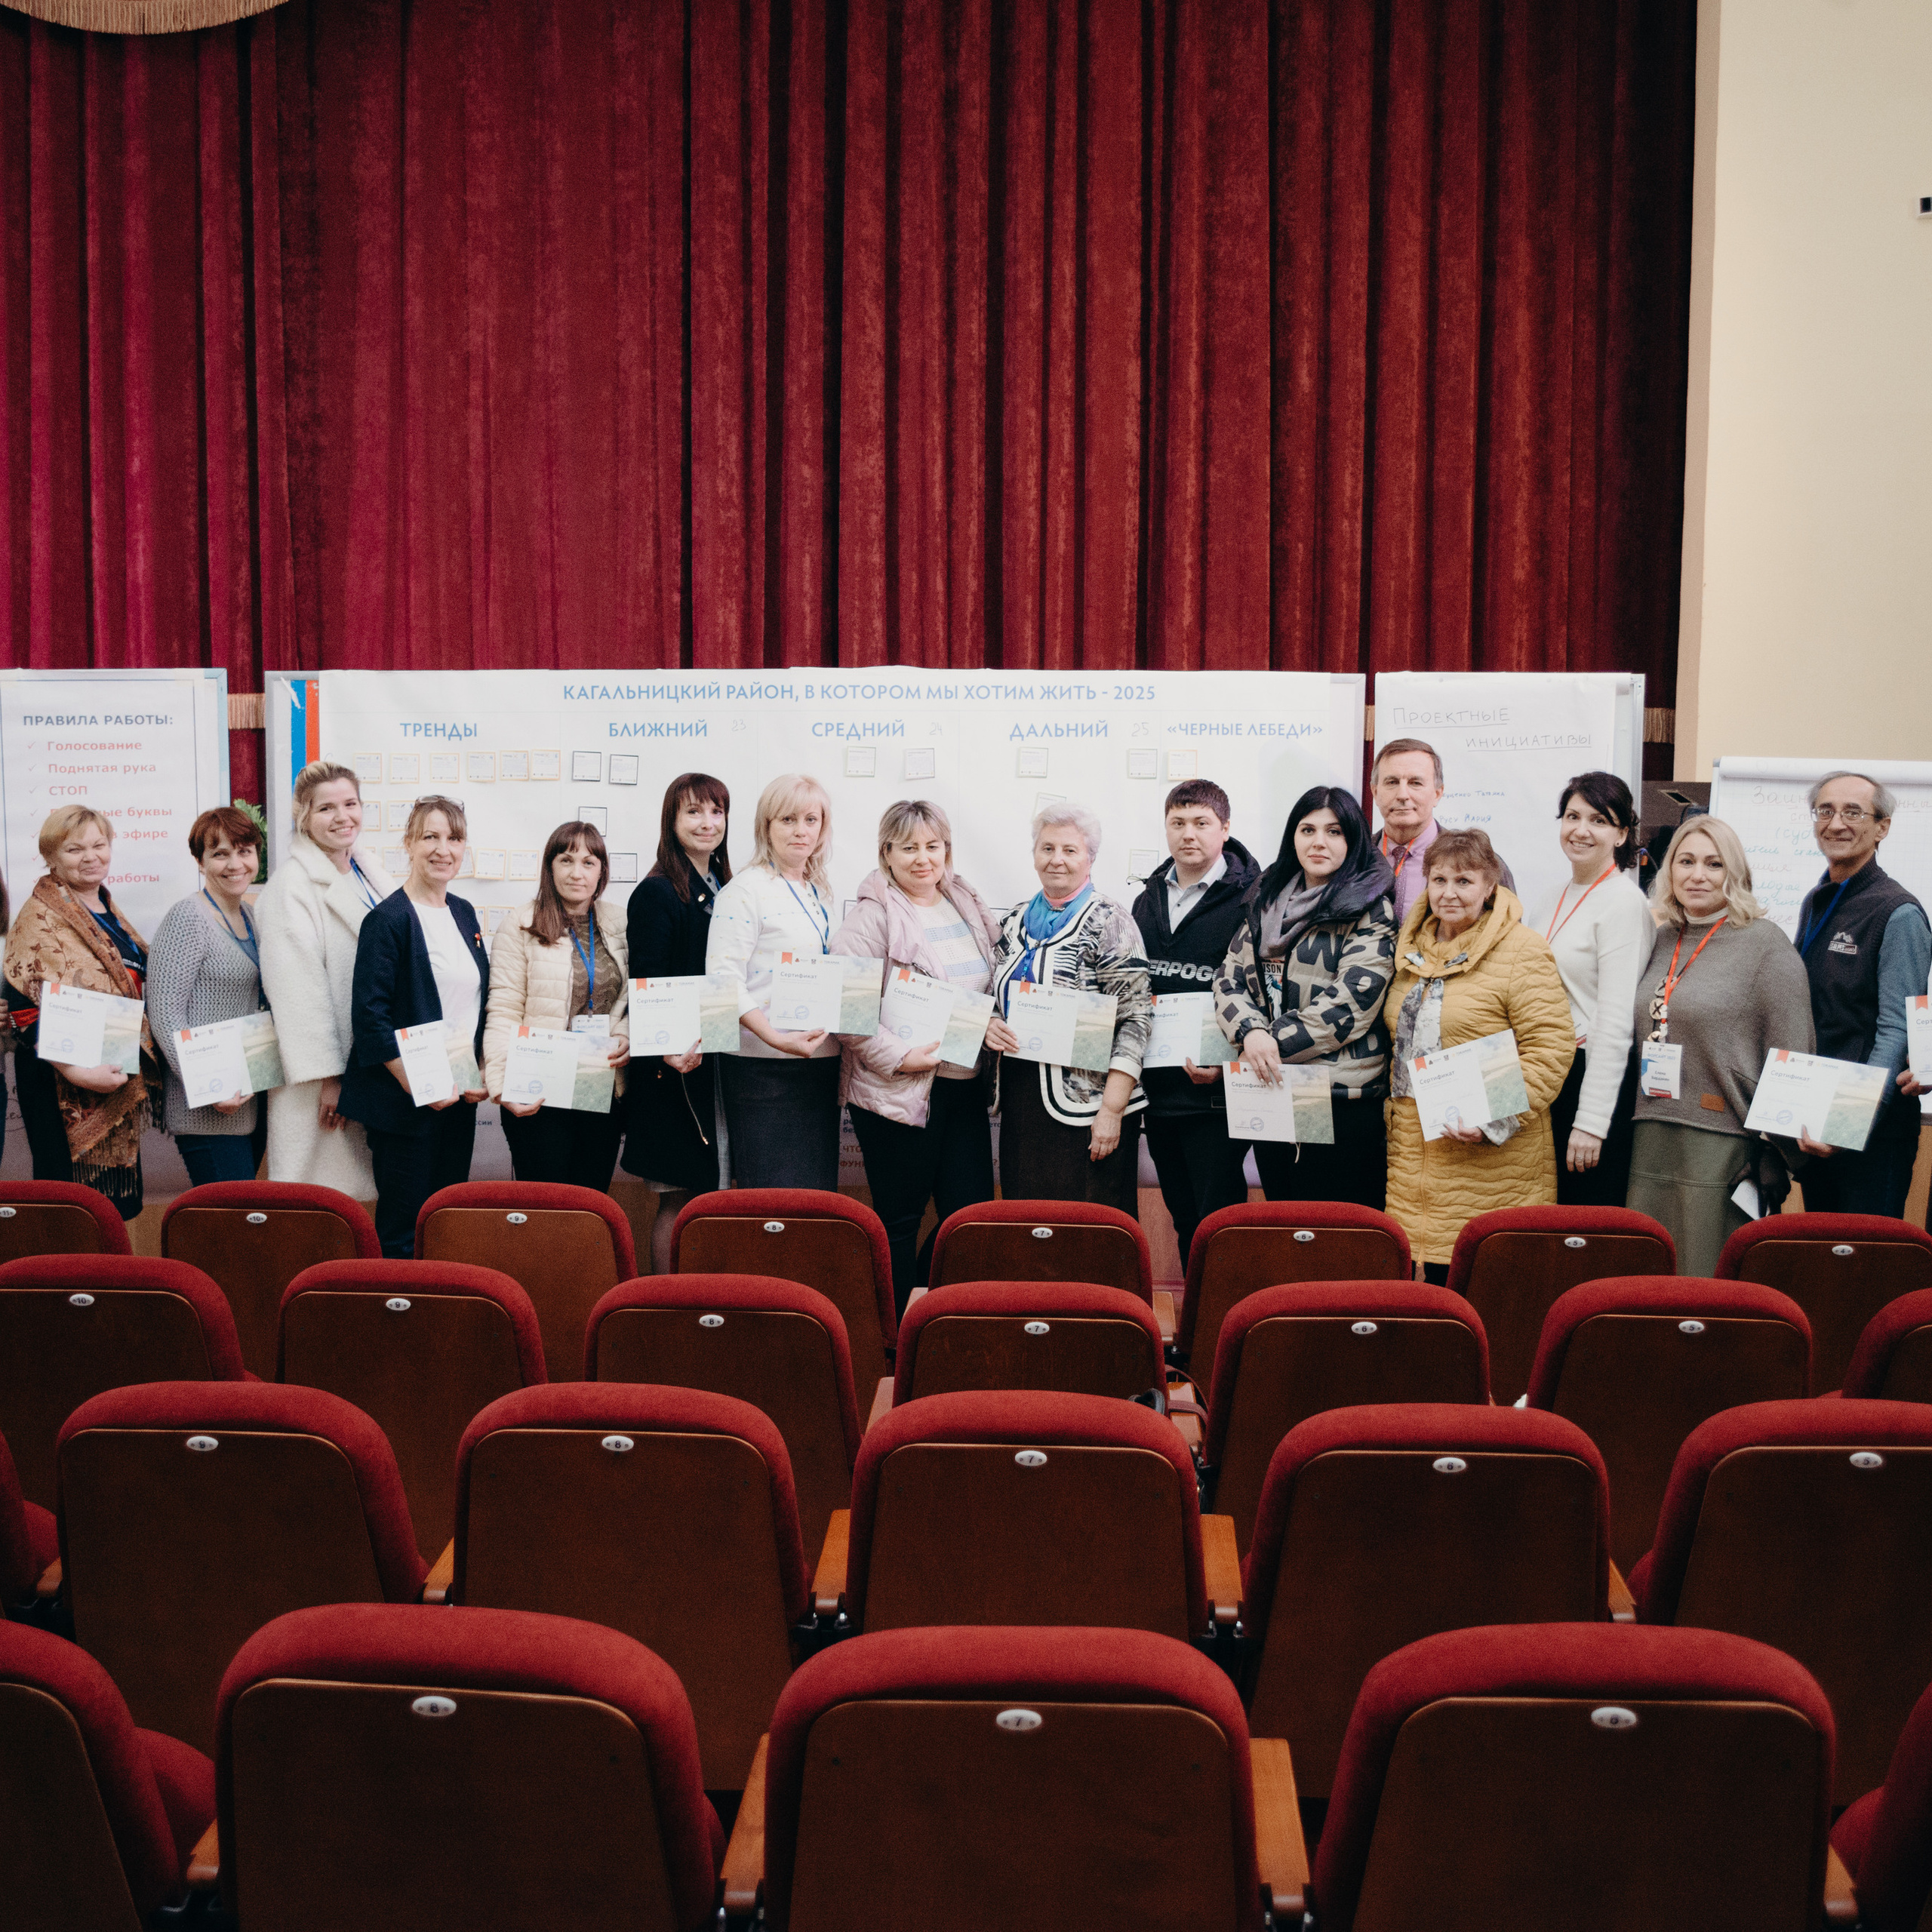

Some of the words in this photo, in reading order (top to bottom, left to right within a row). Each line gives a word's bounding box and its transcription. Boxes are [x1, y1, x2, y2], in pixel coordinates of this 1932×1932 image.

[563, 681, 721, 703] КАГАЛЬНИЦКИЙ
[726, 681, 798, 702] РАЙОН,
[805, 685, 815, 699] В
[820, 685, 921, 700] КОТОРОМ
[927, 685, 958, 700] МЫ
[964, 685, 1035, 700] ХОТИМ
[1040, 686, 1096, 700] ЖИТЬ
[1113, 686, 1155, 700] 2025
[23, 715, 98, 726] ПРАВИЛА
[104, 715, 173, 725] РАБОТЫ:
[731, 719, 746, 732] 23
[400, 723, 478, 740] ТРЕНДЫ
[609, 719, 708, 737] БЛИЖНИЙ
[811, 719, 905, 740] СРЕДНИЙ
[928, 721, 943, 737] 24
[1010, 720, 1109, 741] ДАЛЬНИЙ
[1131, 721, 1150, 737] 25
[1167, 723, 1243, 736] «ЧЕРНЫЕ
[1247, 723, 1323, 739] ЛЕБЕДИ»
[48, 742, 142, 751] Голосование
[1466, 734, 1592, 749] ИНИЦИАТИВЫ
[48, 764, 118, 774] Поднятая
[123, 764, 156, 774] рука
[49, 786, 88, 796] СТОП
[127, 808, 172, 818] буквы
[123, 829, 168, 840] эфире
[107, 873, 159, 884] работы
[894, 987, 930, 1002] Сертификат
[1017, 1001, 1053, 1011] Сертификат
[185, 1044, 219, 1055] Сертификат
[516, 1045, 553, 1054] Сертификат
[1419, 1070, 1455, 1085] Сертификат
[1770, 1070, 1811, 1082] Сертификат
[615, 1440, 621, 1448] 8
[1029, 1455, 1034, 1463] 7
